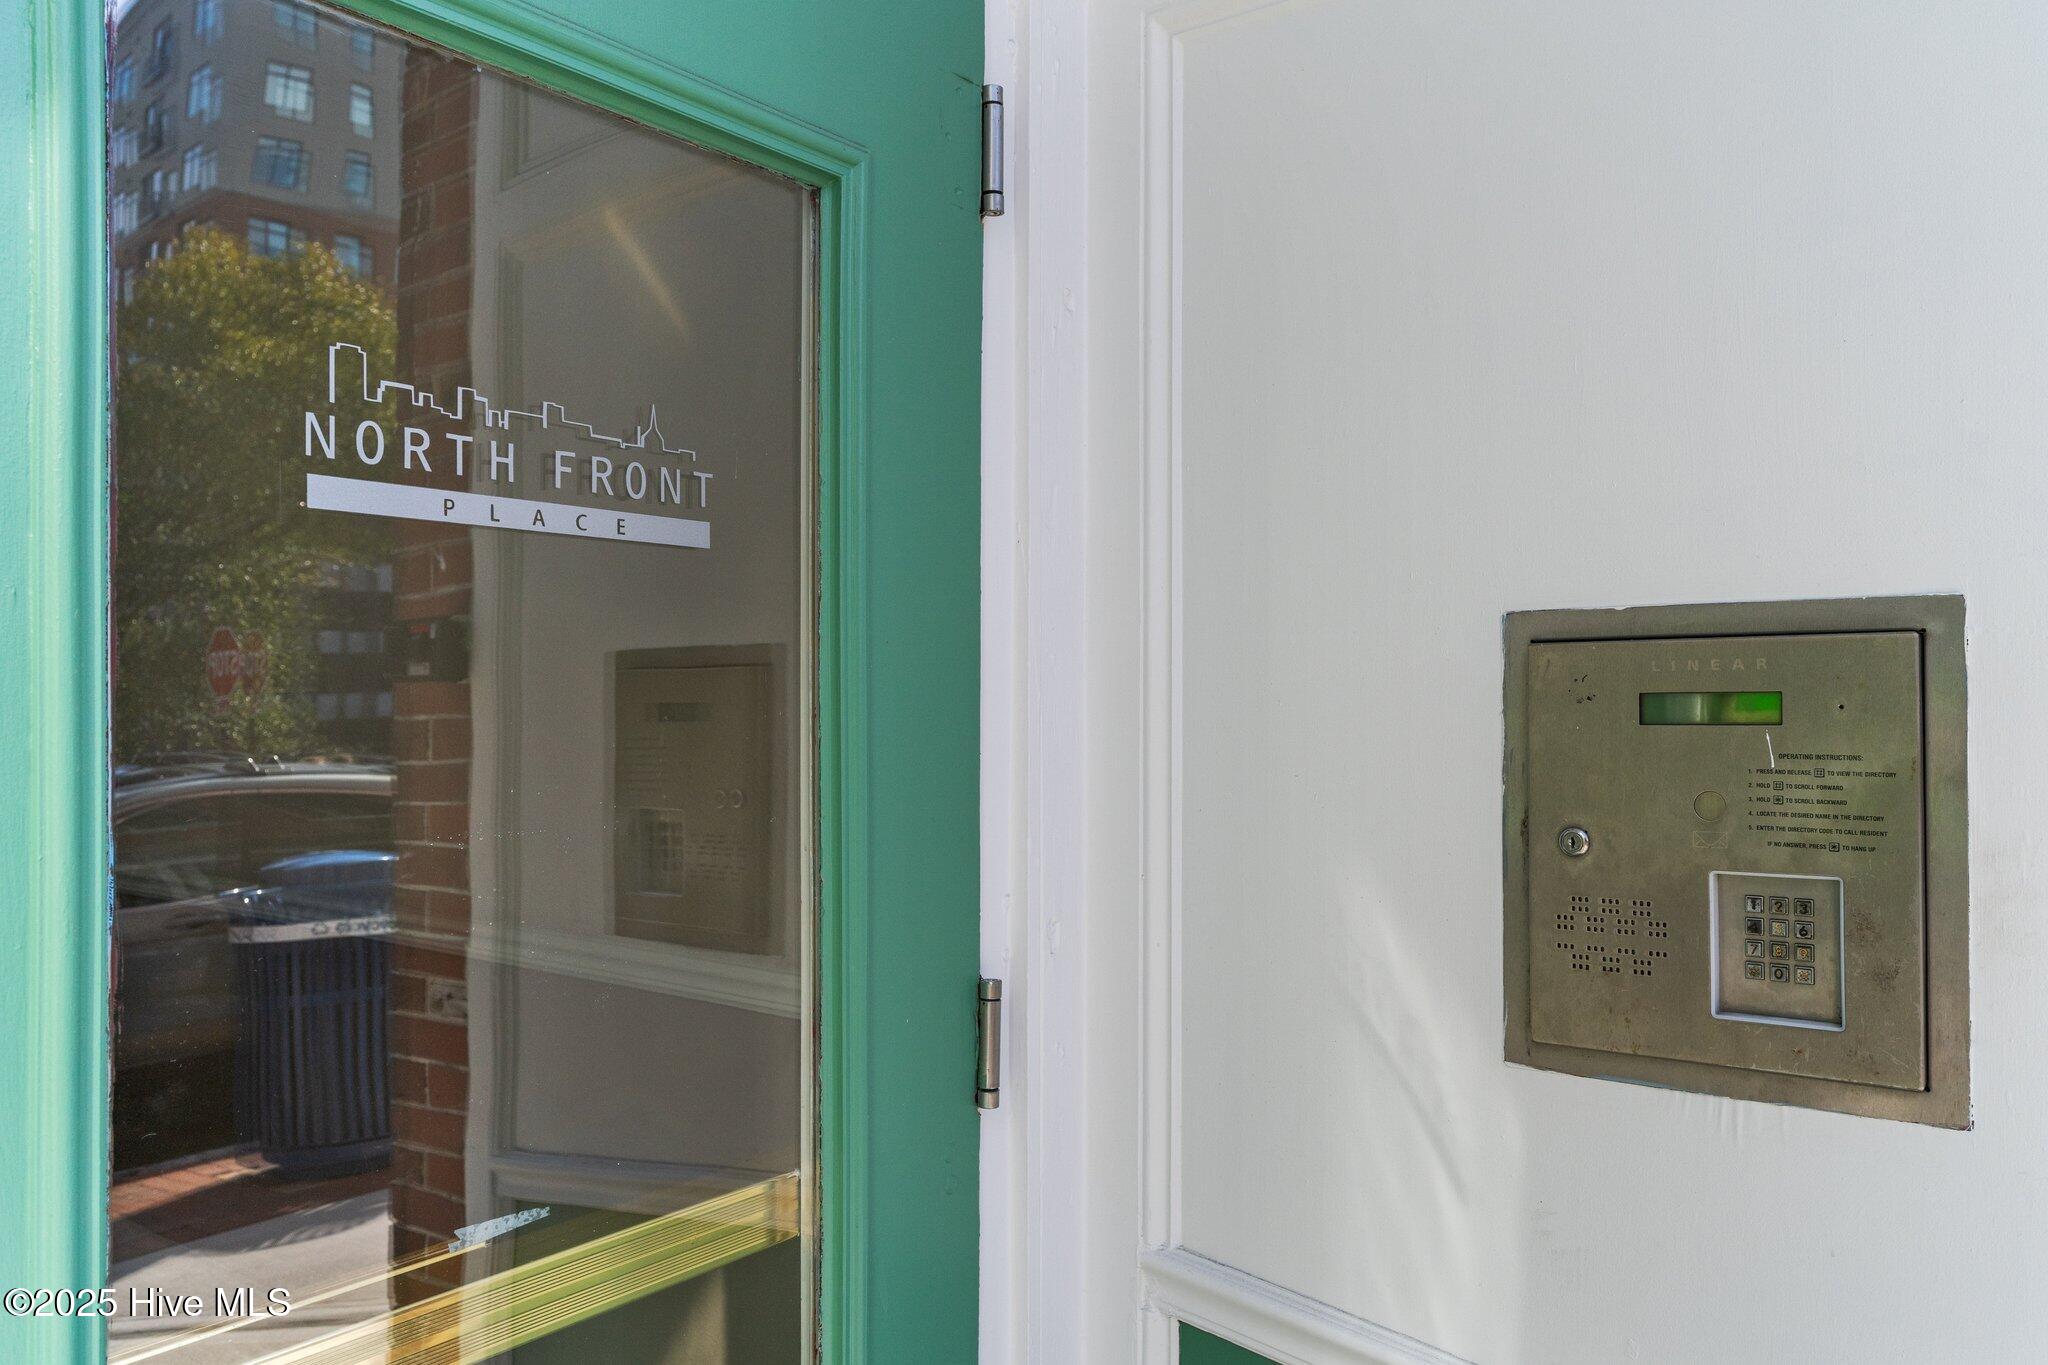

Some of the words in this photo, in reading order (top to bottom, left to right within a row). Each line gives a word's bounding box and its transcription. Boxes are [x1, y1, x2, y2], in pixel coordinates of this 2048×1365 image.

[305, 411, 514, 483] NORTH
[555, 450, 713, 508] FRONT
[444, 499, 626, 536] PLACE
[1652, 658, 1767, 672] LINEAR
[1778, 753, 1814, 761] OPERATING
[1815, 754, 1864, 762] INSTRUCTIONS:
[1774, 901, 1783, 912] 2
[1799, 903, 1809, 914] 3
[1799, 926, 1808, 937] 6
[1750, 944, 1759, 955] 7
[1774, 968, 1784, 980] 0
